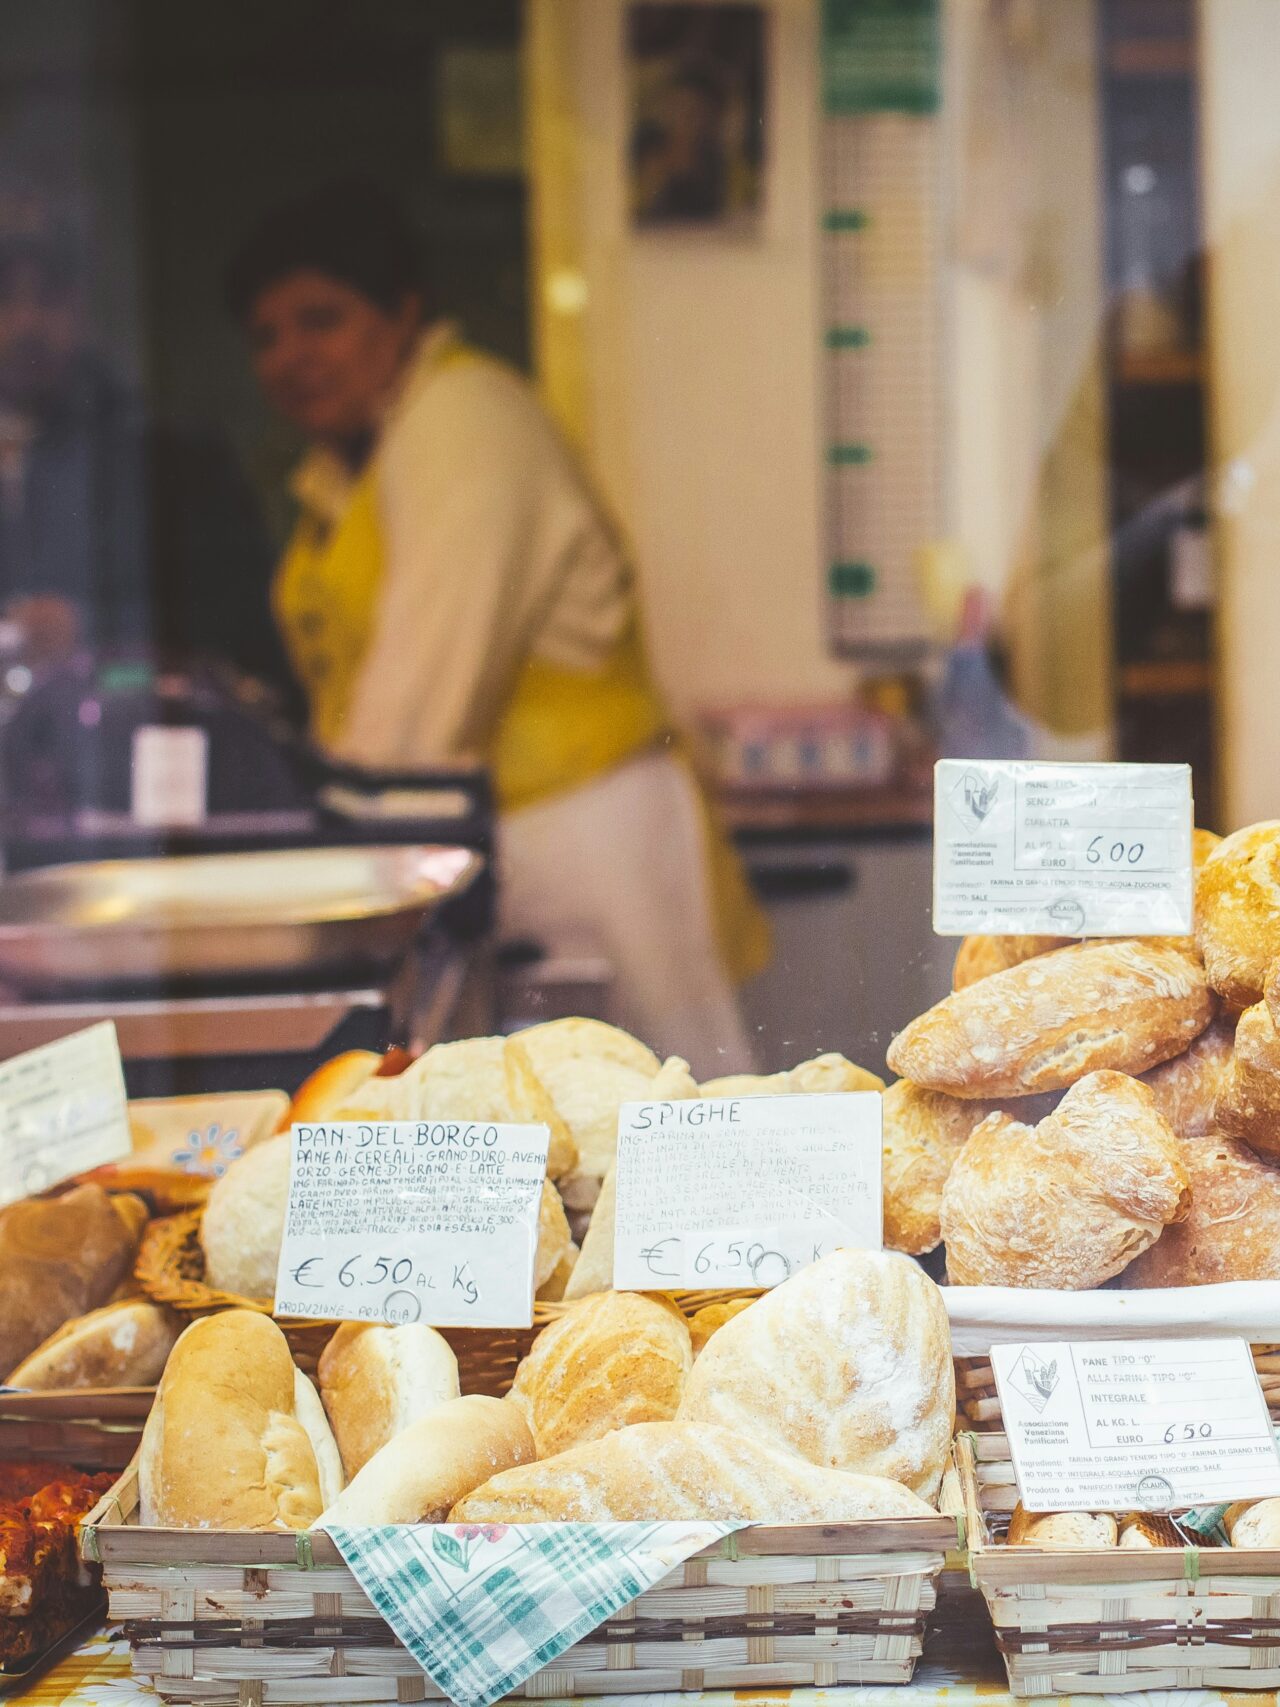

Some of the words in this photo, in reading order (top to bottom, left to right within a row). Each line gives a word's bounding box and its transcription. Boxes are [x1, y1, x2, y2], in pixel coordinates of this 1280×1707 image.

[1040, 858, 1067, 867] EURO
[970, 894, 988, 902] SALE
[630, 1102, 741, 1130] SPIGHE
[297, 1127, 344, 1147] PAN
[354, 1125, 405, 1148] DEL
[413, 1123, 499, 1148] BORGO
[297, 1149, 330, 1165] PANE
[426, 1149, 468, 1162] GRANO
[469, 1150, 506, 1165] DURO
[511, 1150, 547, 1164] AVENA
[296, 1166, 331, 1177] ORZO
[338, 1164, 382, 1177] GERME
[386, 1164, 401, 1177] DI
[407, 1163, 448, 1175] GRANO
[469, 1163, 505, 1175] LATTE
[290, 1198, 319, 1210] LATTE
[637, 1237, 681, 1277] €
[289, 1257, 325, 1288] €
[338, 1254, 413, 1288] 6.50
[416, 1273, 437, 1289] AL
[452, 1262, 479, 1304] Kg
[278, 1300, 345, 1316] PRODUZIONE
[1082, 1357, 1109, 1367] PANE
[1111, 1355, 1136, 1365] TIPO
[1087, 1373, 1112, 1383] ALLA
[1113, 1372, 1150, 1383] FARINA
[1151, 1372, 1176, 1382] TIPO
[1091, 1393, 1147, 1403] INTEGRALE
[1096, 1418, 1110, 1428] AL
[1024, 1428, 1065, 1437] Veneziana
[1024, 1437, 1070, 1446] Panificatori
[1117, 1435, 1144, 1444] EURO
[1103, 1455, 1129, 1463] GRANO
[1130, 1454, 1158, 1463] TENERO
[1227, 1447, 1253, 1456] GRANO
[1026, 1485, 1061, 1494] Prodotto
